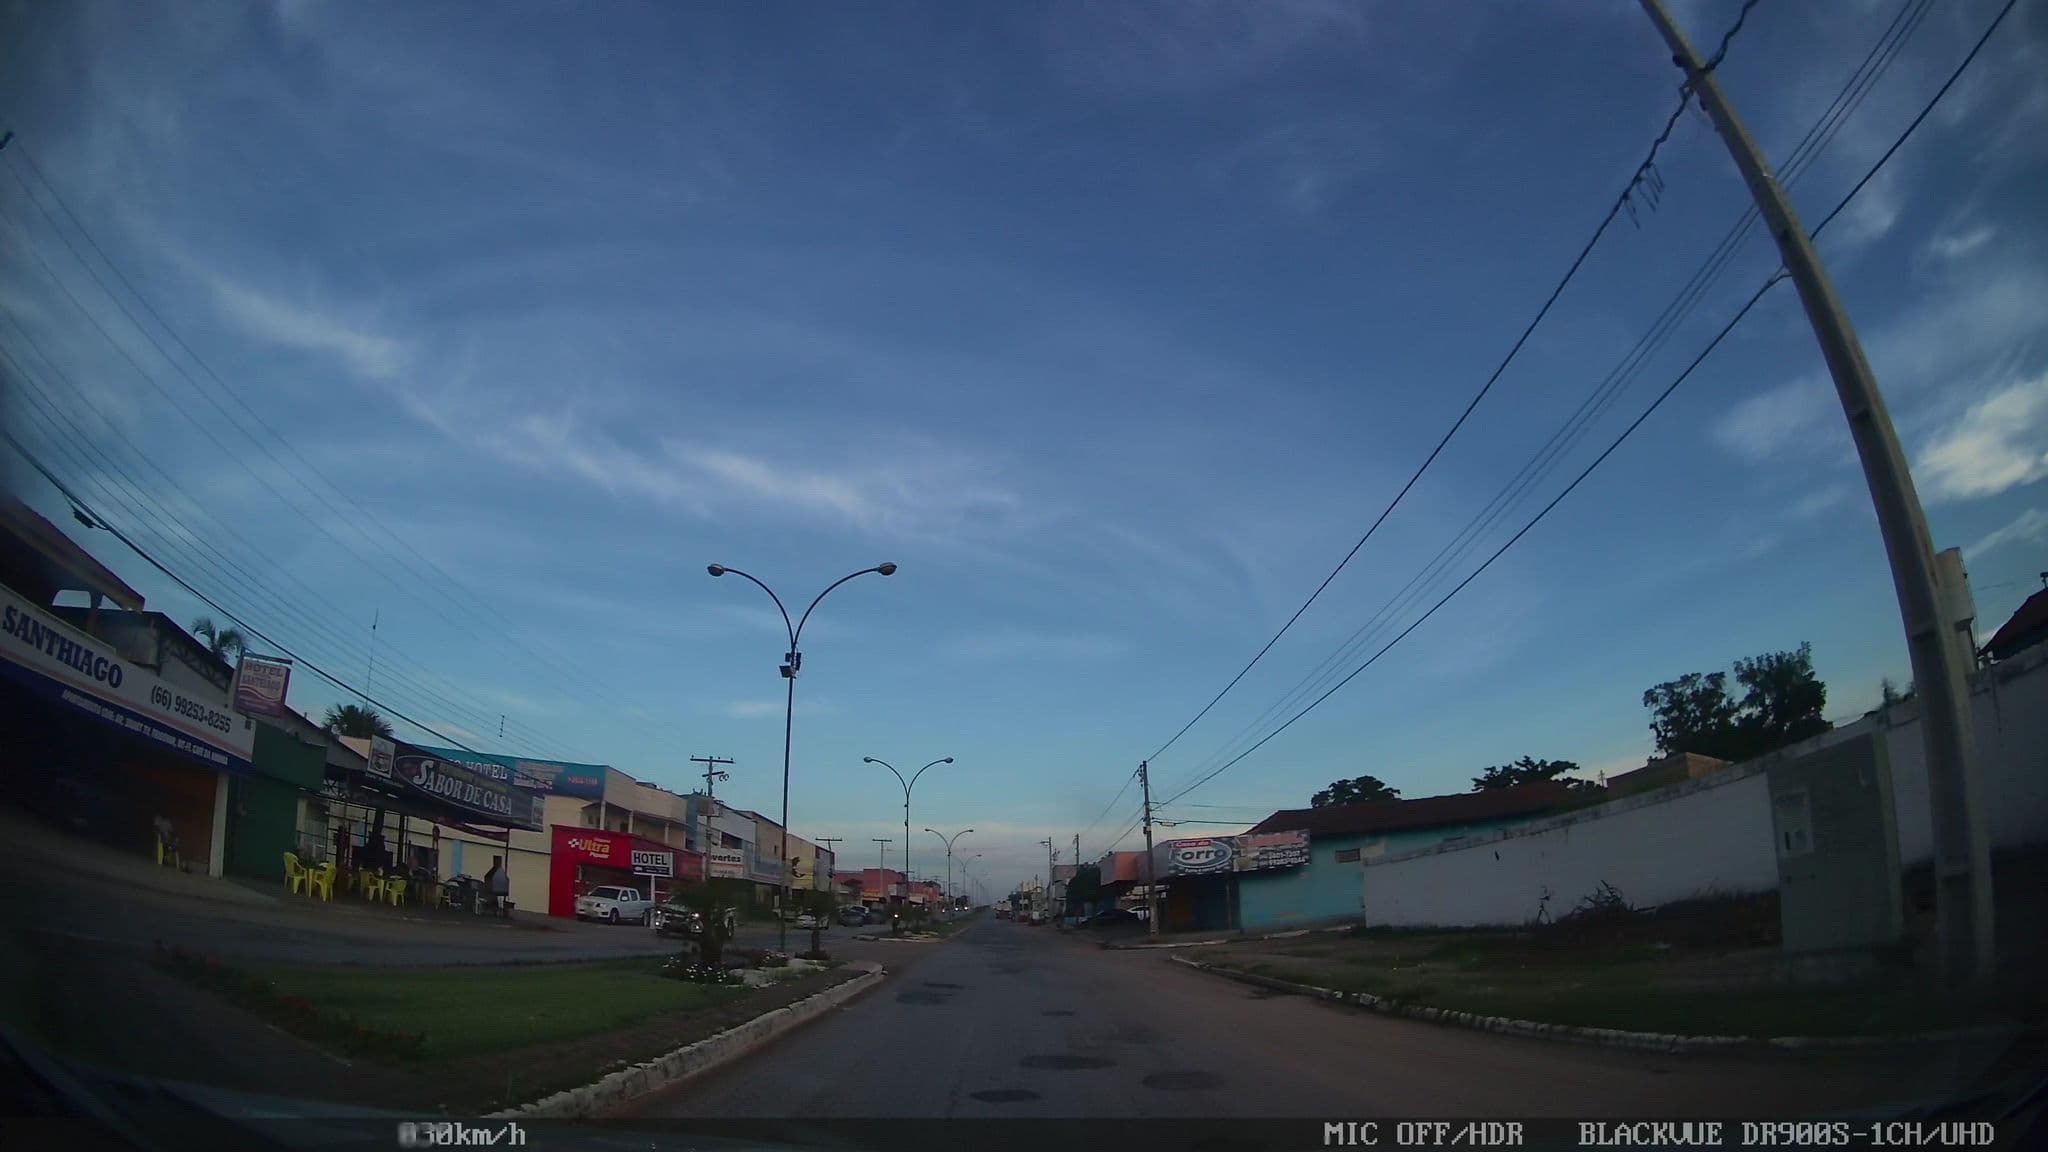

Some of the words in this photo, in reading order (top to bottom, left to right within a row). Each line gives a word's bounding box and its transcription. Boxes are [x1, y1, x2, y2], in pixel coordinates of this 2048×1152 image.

[2, 605, 122, 688] SANTHIAGO
[243, 661, 283, 677] HOTEL
[151, 685, 172, 711] (66)
[412, 760, 461, 800] SABOR
[464, 783, 481, 805] DE
[483, 790, 512, 815] CASA
[579, 839, 610, 853] Ultra
[633, 852, 668, 865] HOTEL
